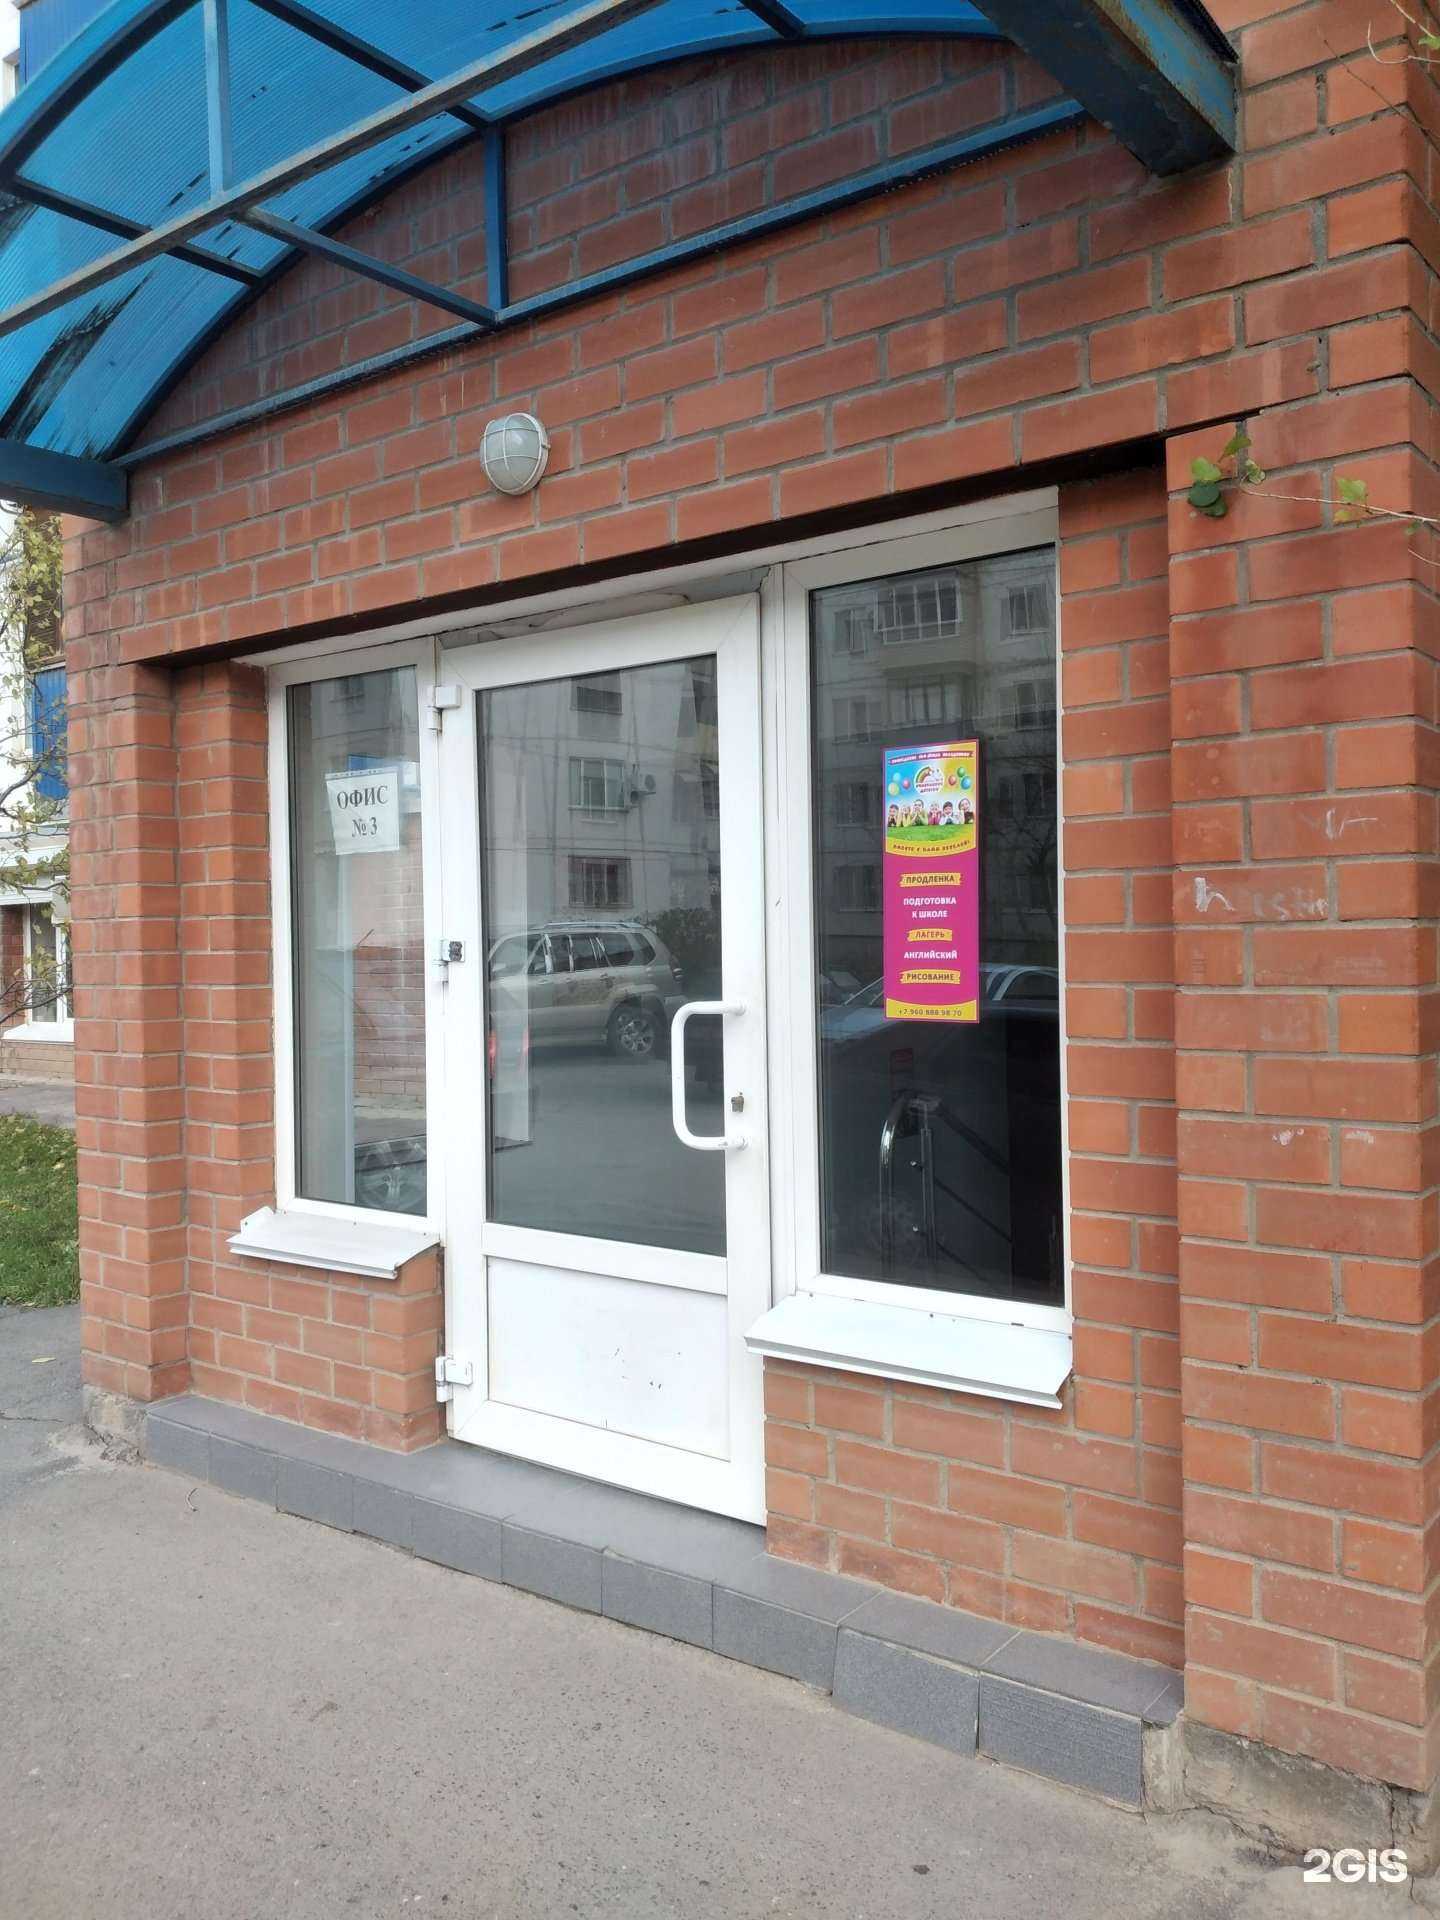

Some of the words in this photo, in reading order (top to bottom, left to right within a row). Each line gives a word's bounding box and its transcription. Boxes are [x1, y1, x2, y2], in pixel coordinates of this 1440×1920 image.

[336, 785, 388, 809] ОФИС
[906, 875, 955, 884] ПРОДЛЕНКА
[903, 897, 957, 906] ПОДГОТОВКА
[919, 910, 948, 918] ШКОЛЕ
[903, 950, 958, 959] АНГЛИЙСКИЙ
[906, 973, 955, 981] РИСОВАНИЕ
